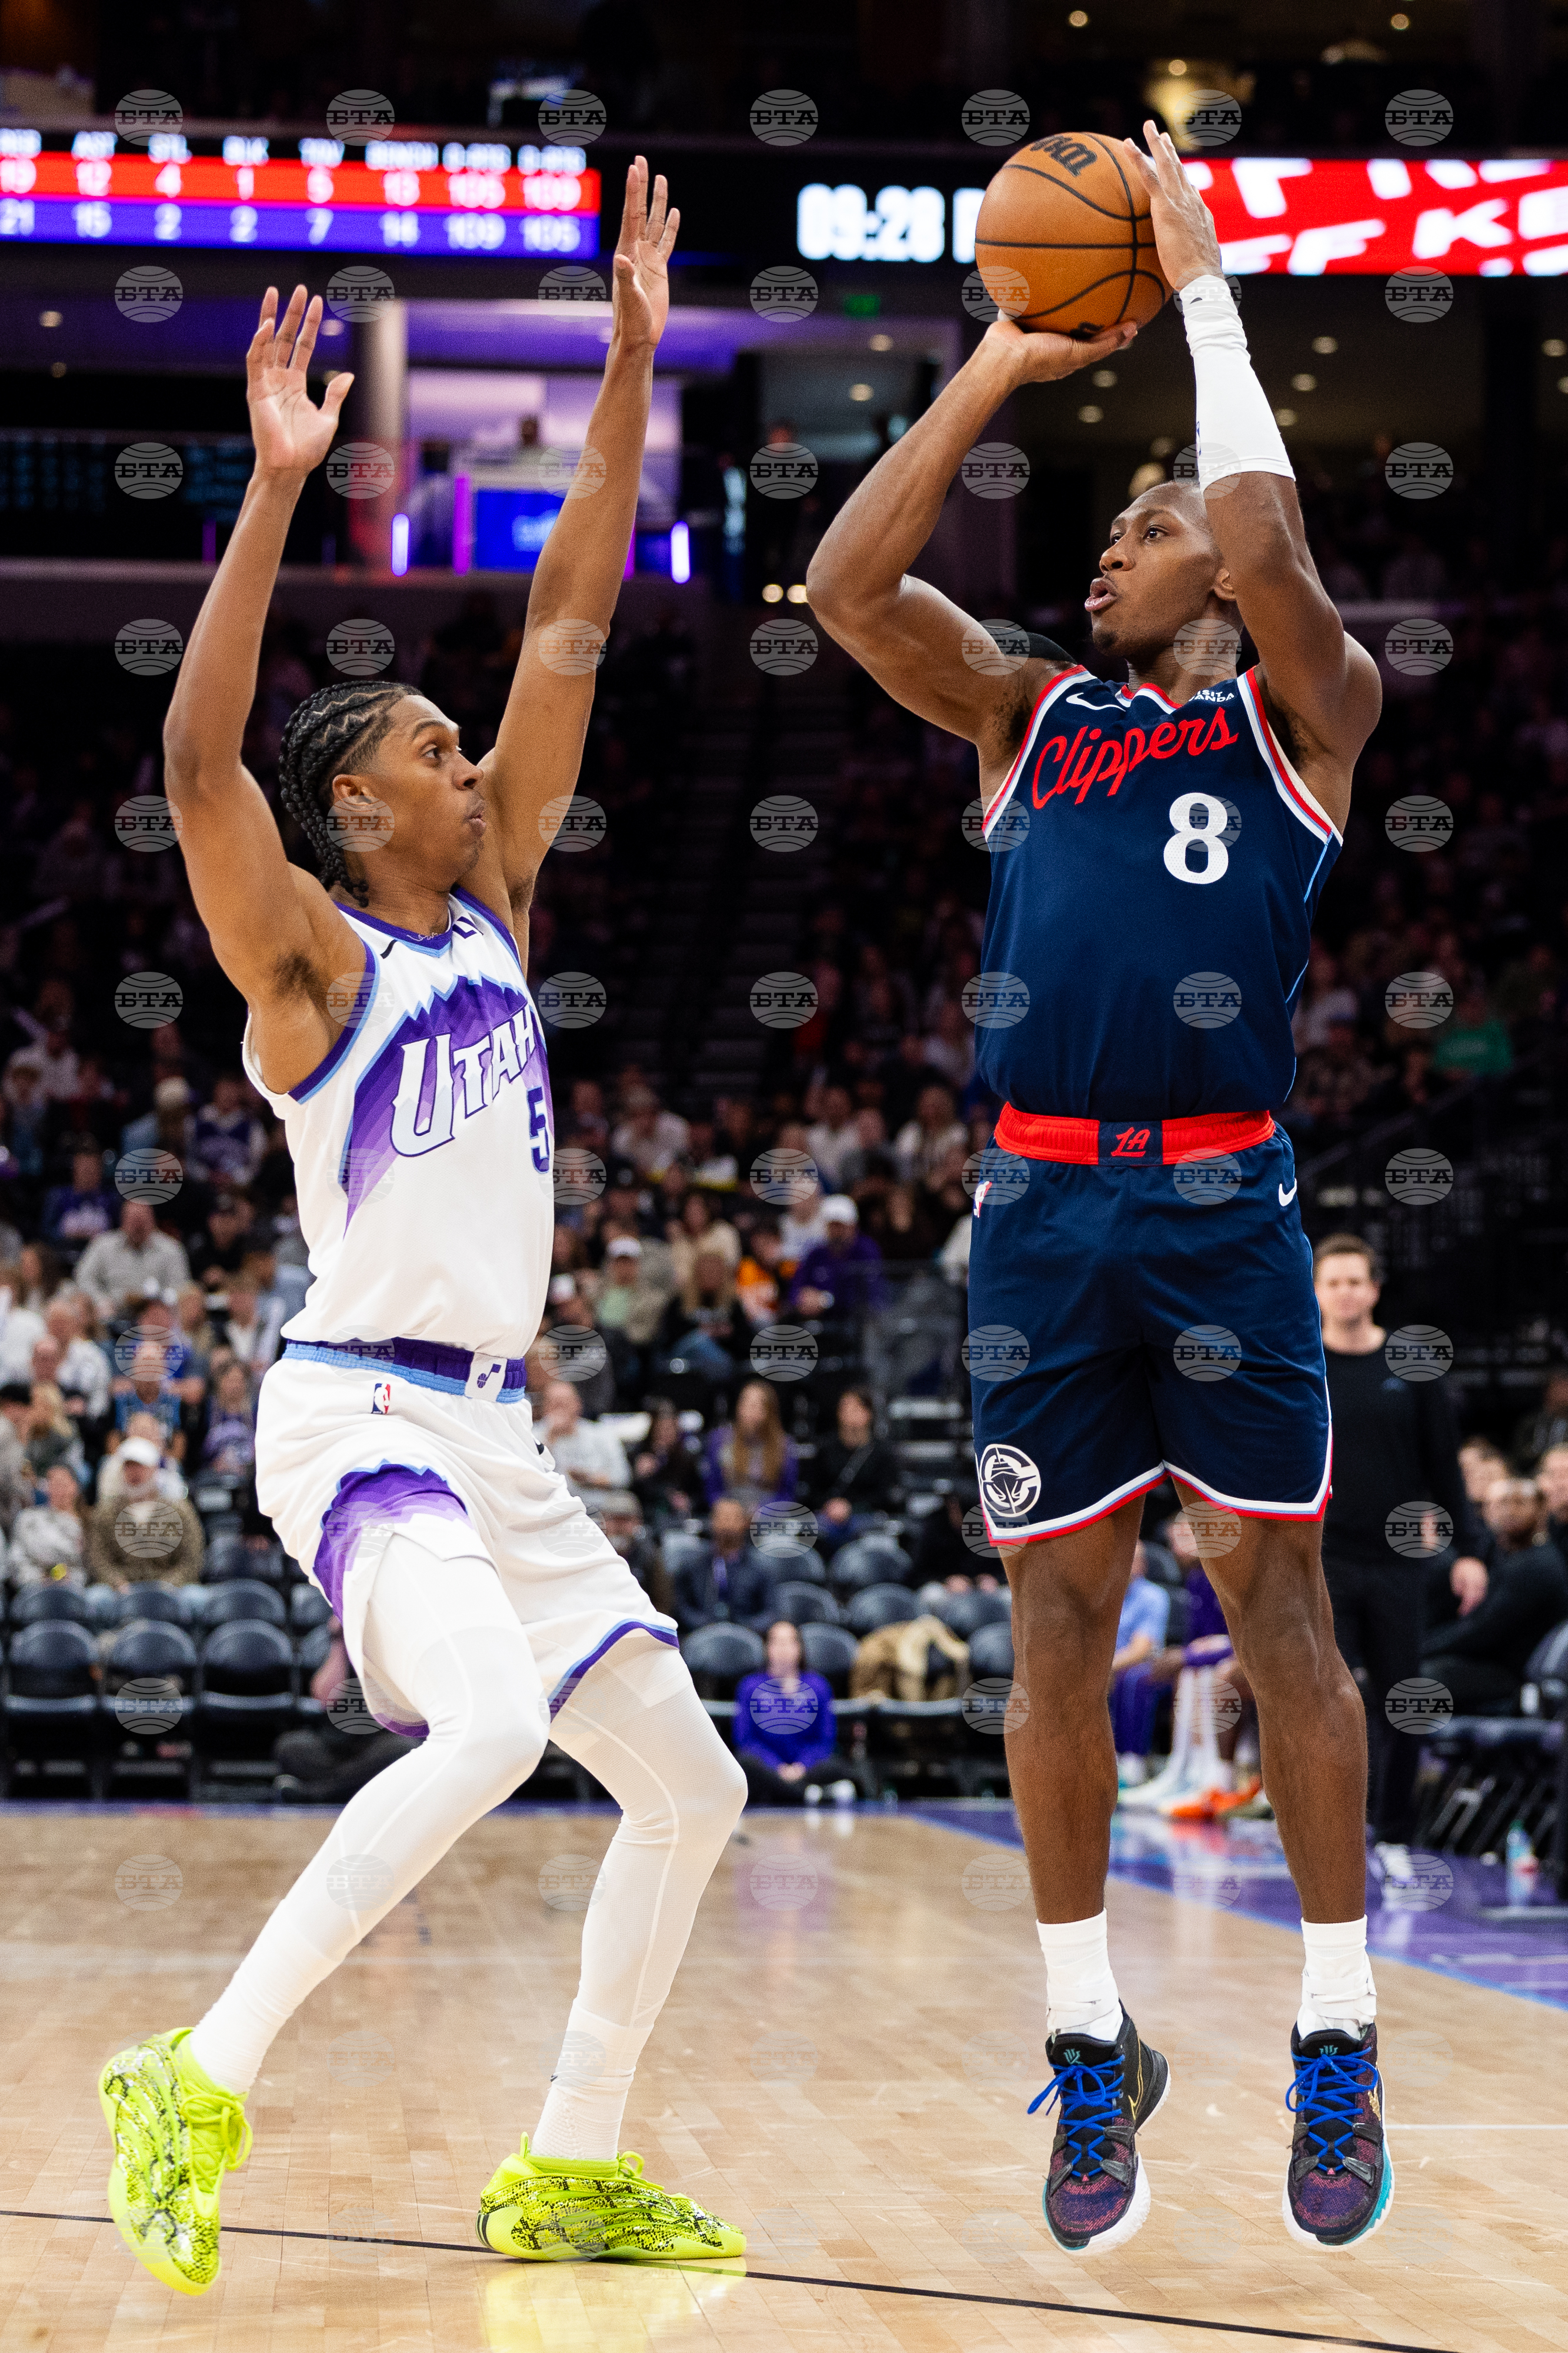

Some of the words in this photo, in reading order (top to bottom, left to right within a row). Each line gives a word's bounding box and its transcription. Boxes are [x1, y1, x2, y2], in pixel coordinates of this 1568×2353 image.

[154, 164, 182, 198] 4
[234, 166, 254, 200] 1
[154, 202, 182, 240] 2
[230, 205, 258, 242] 2
[305, 208, 333, 245] 7
[1197, 689, 1223, 698] ISIT
[1032, 706, 1239, 809] Clippers
[1163, 792, 1228, 884] 8
[390, 1005, 535, 1157] UTAH
[526, 1085, 550, 1174] 5
[1110, 1126, 1150, 1158] LA
